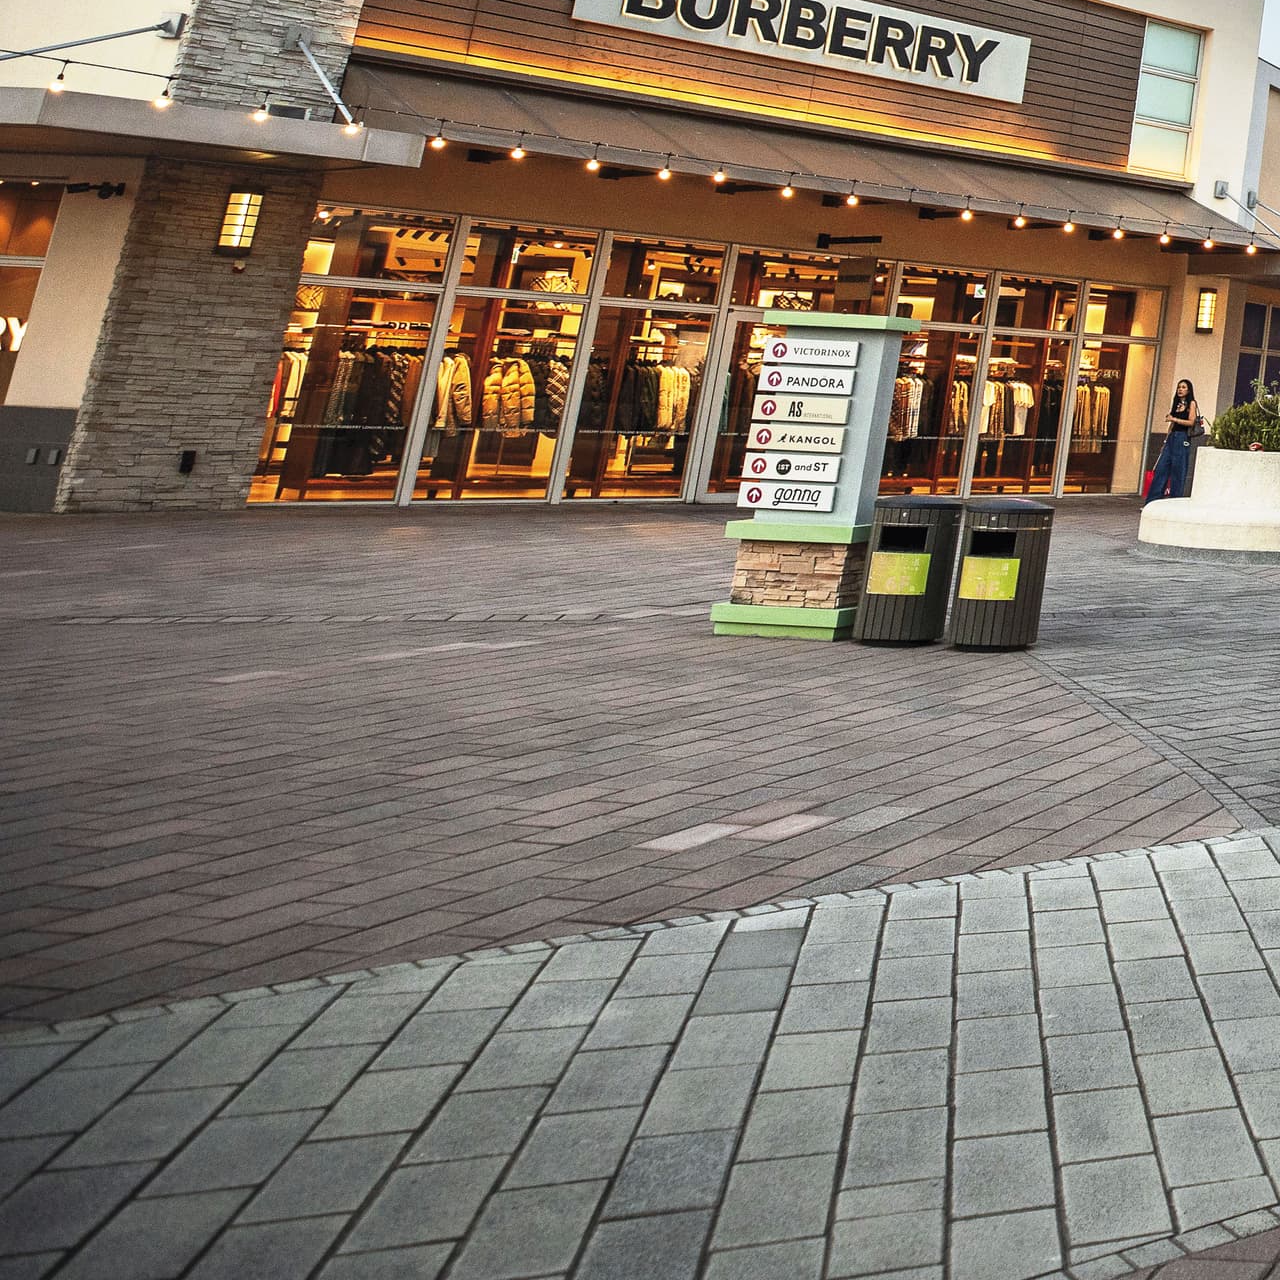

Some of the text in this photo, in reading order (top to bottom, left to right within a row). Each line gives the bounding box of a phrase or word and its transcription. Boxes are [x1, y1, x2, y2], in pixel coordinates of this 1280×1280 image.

[793, 347, 851, 358] VICTORINOX
[786, 376, 845, 389] PANDORA
[787, 400, 804, 418] AS
[788, 434, 836, 446] KANGOL
[794, 463, 813, 472] and
[813, 462, 829, 472] ST
[772, 488, 821, 507] gonna
